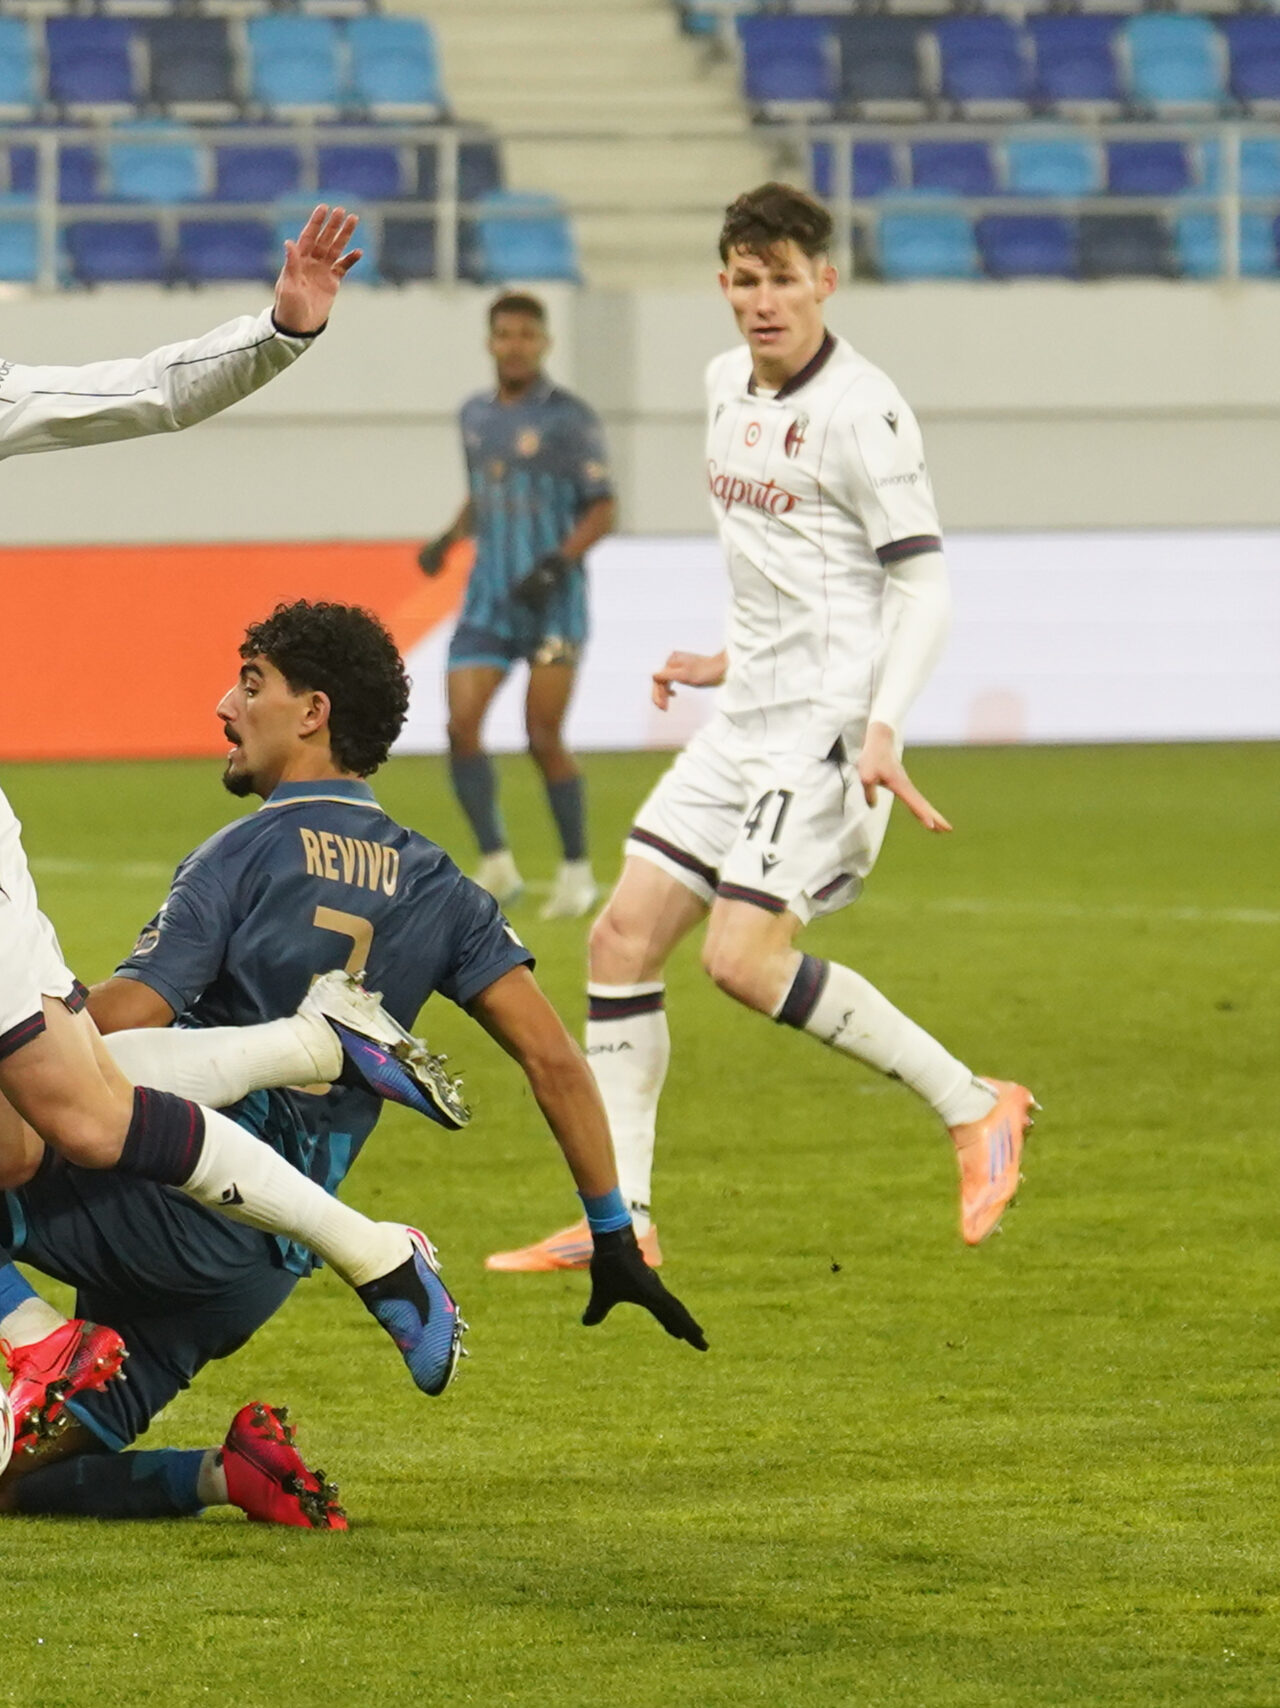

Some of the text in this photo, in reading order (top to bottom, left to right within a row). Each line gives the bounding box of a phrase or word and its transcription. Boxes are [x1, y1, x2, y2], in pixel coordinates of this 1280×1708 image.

[707, 459, 803, 513] Saputo
[743, 788, 795, 846] 41
[299, 827, 400, 897] REVIVO
